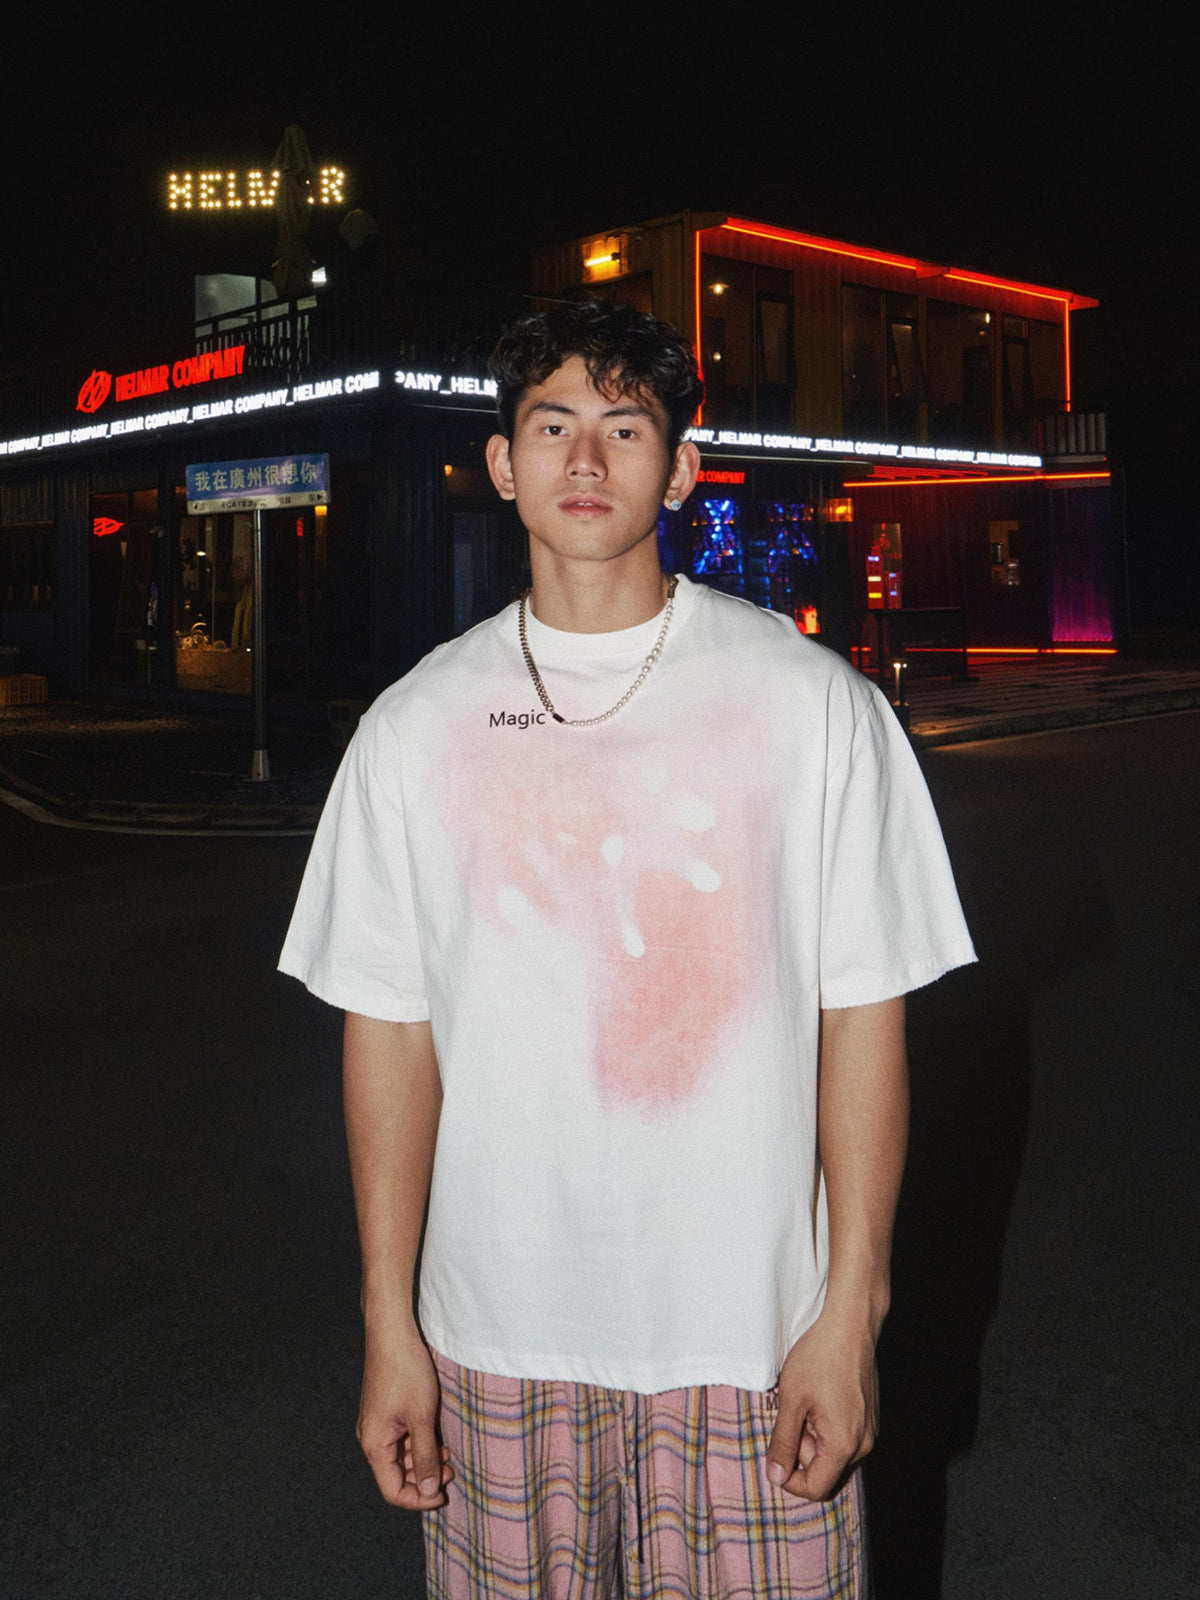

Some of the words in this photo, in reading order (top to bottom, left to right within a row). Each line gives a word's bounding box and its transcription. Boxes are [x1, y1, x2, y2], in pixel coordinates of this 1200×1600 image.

[168, 165, 346, 209] HELMR
[115, 364, 170, 402] HELMAR
[172, 344, 246, 388] COMPANY
[234, 379, 343, 415] COMPANY_HELMAR
[194, 462, 318, 492] 我在廣州很想你
[489, 709, 546, 730] Magic
